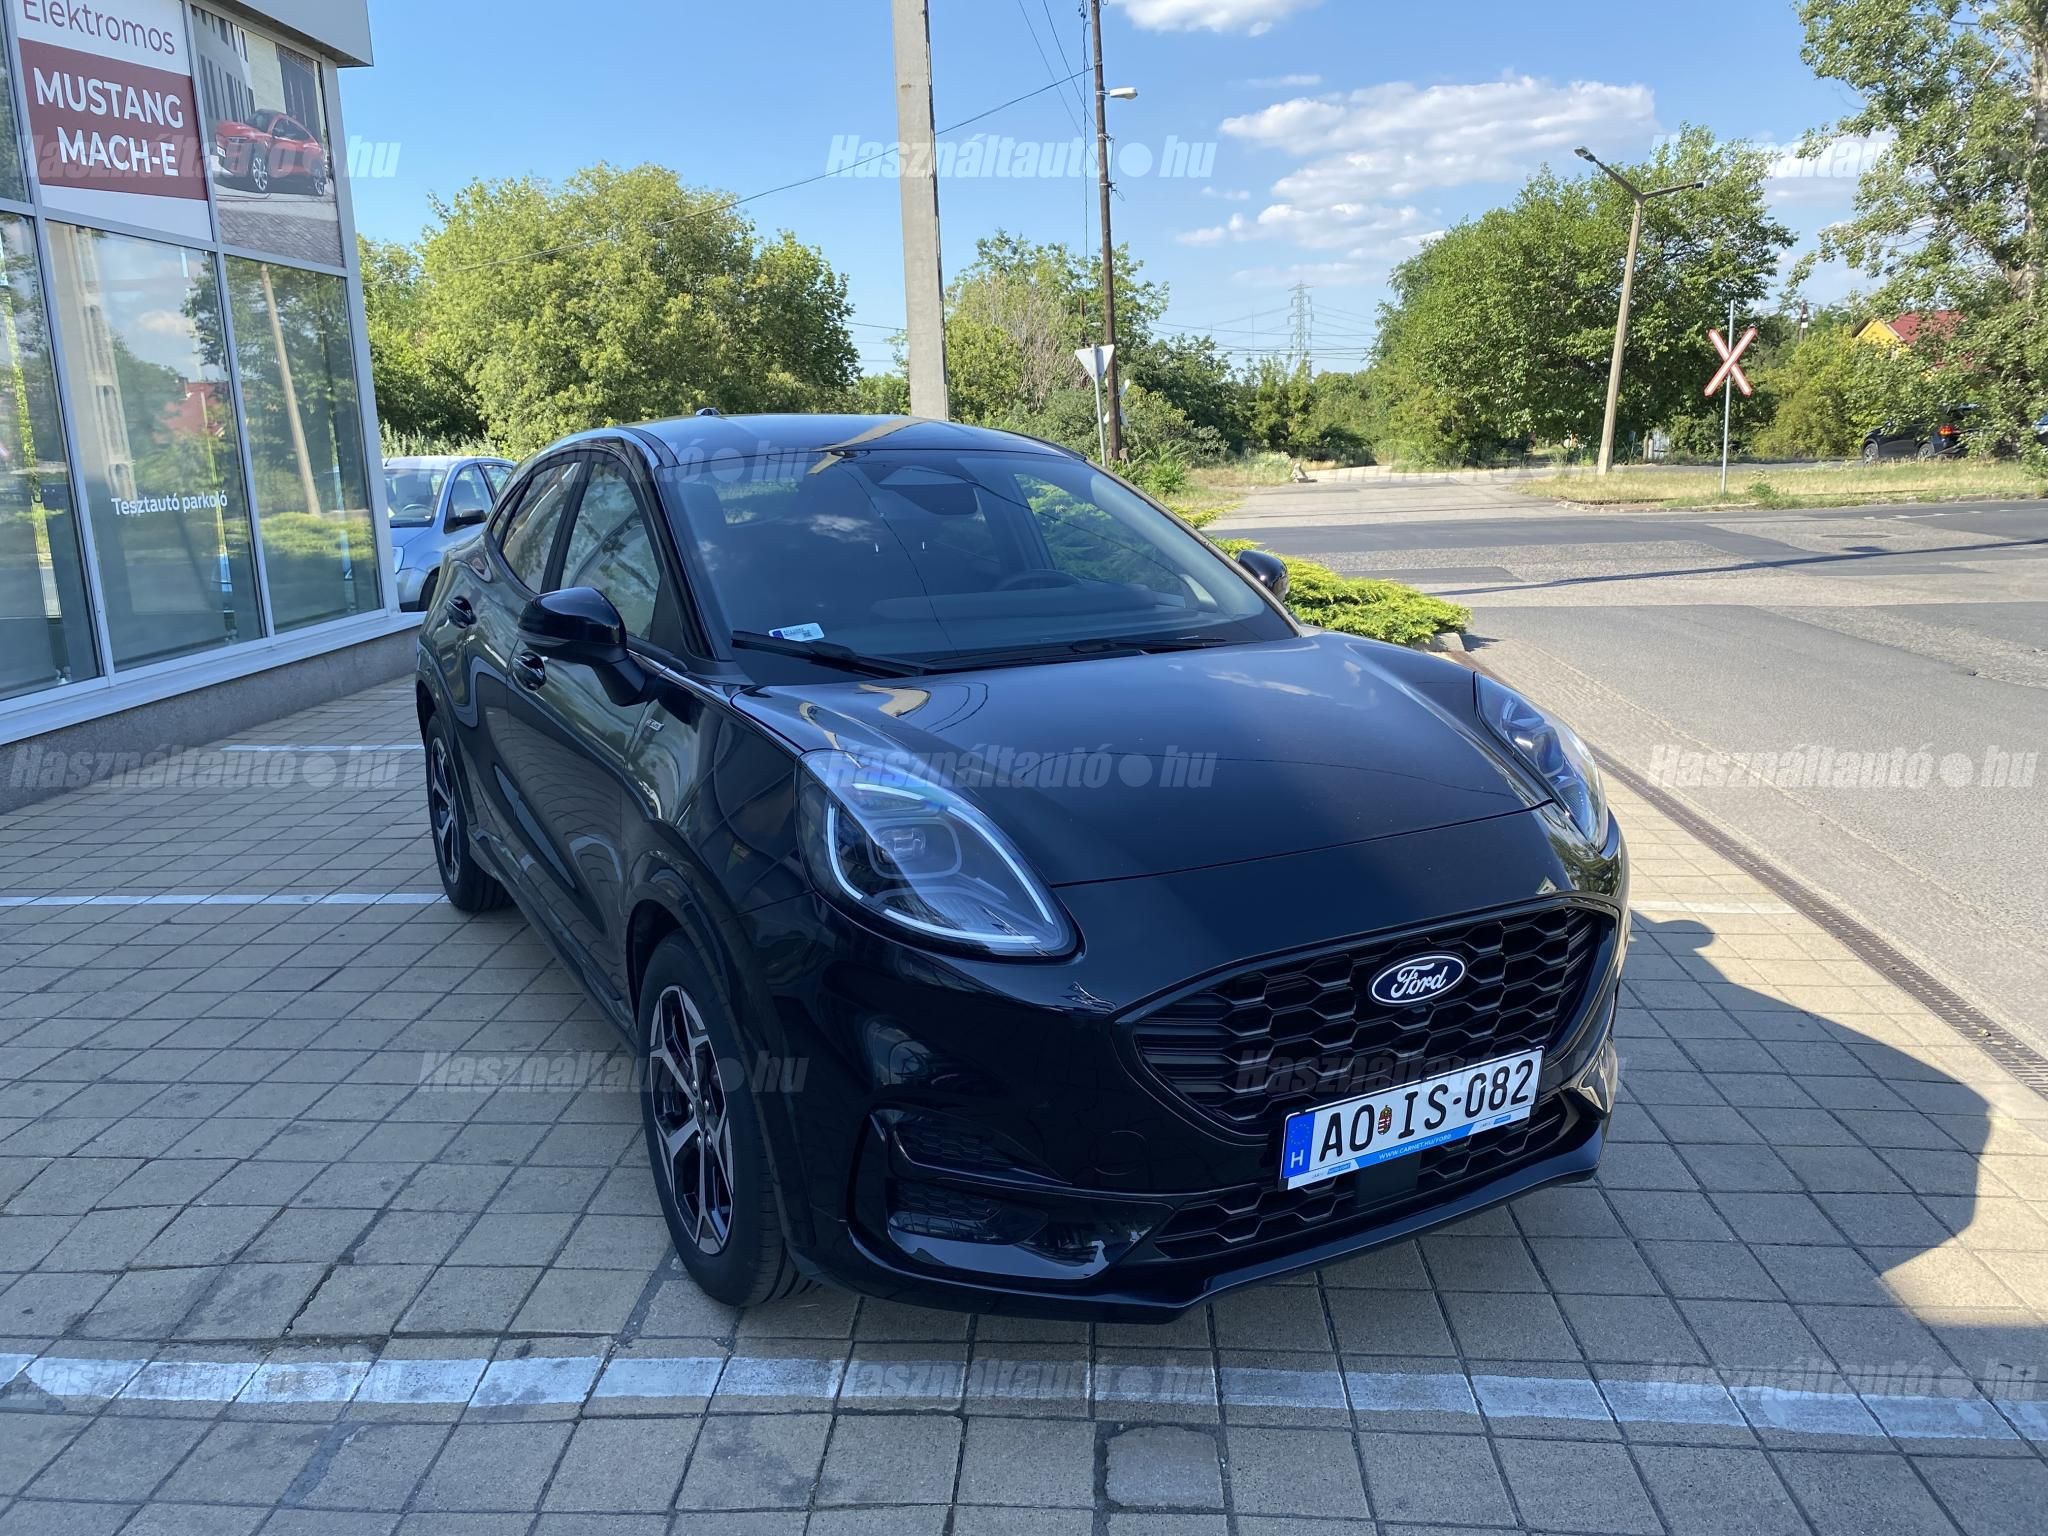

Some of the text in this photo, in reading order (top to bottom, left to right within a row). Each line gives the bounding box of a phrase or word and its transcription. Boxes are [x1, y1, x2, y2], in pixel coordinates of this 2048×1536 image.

[23, 0, 175, 55] Elektromos
[33, 68, 184, 128] MUSTANG
[57, 126, 179, 177] MACH-E
[111, 490, 228, 516] Tesztautó parkoló
[1390, 961, 1449, 999] Ford
[1290, 1149, 1304, 1168] H
